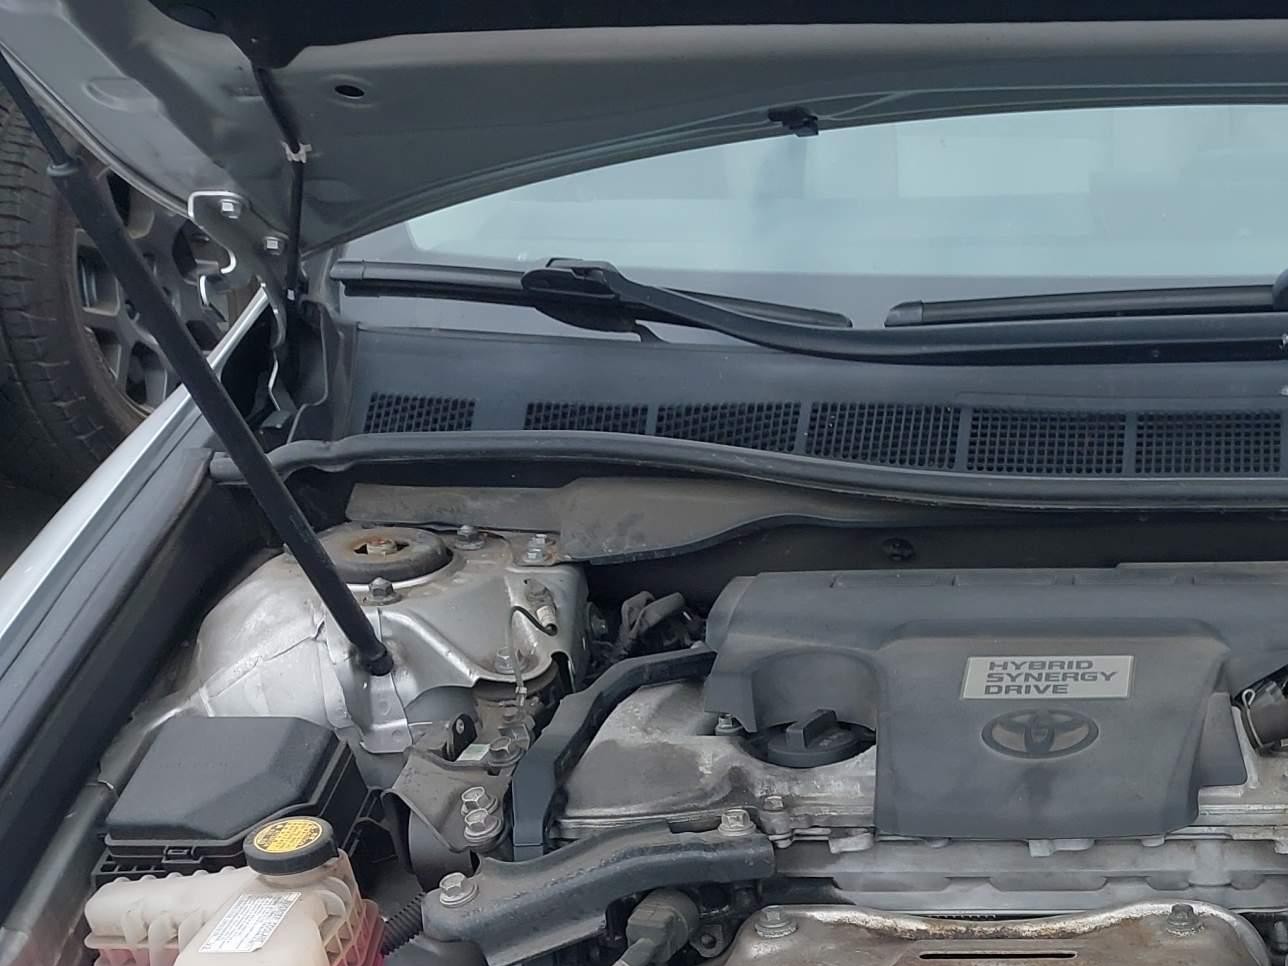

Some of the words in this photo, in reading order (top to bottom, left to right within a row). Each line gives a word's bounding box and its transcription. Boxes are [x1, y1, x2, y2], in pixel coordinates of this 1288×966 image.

[989, 660, 1093, 670] HYBRID
[986, 671, 1117, 682] SYNERGY
[984, 684, 1069, 695] DRIVE
